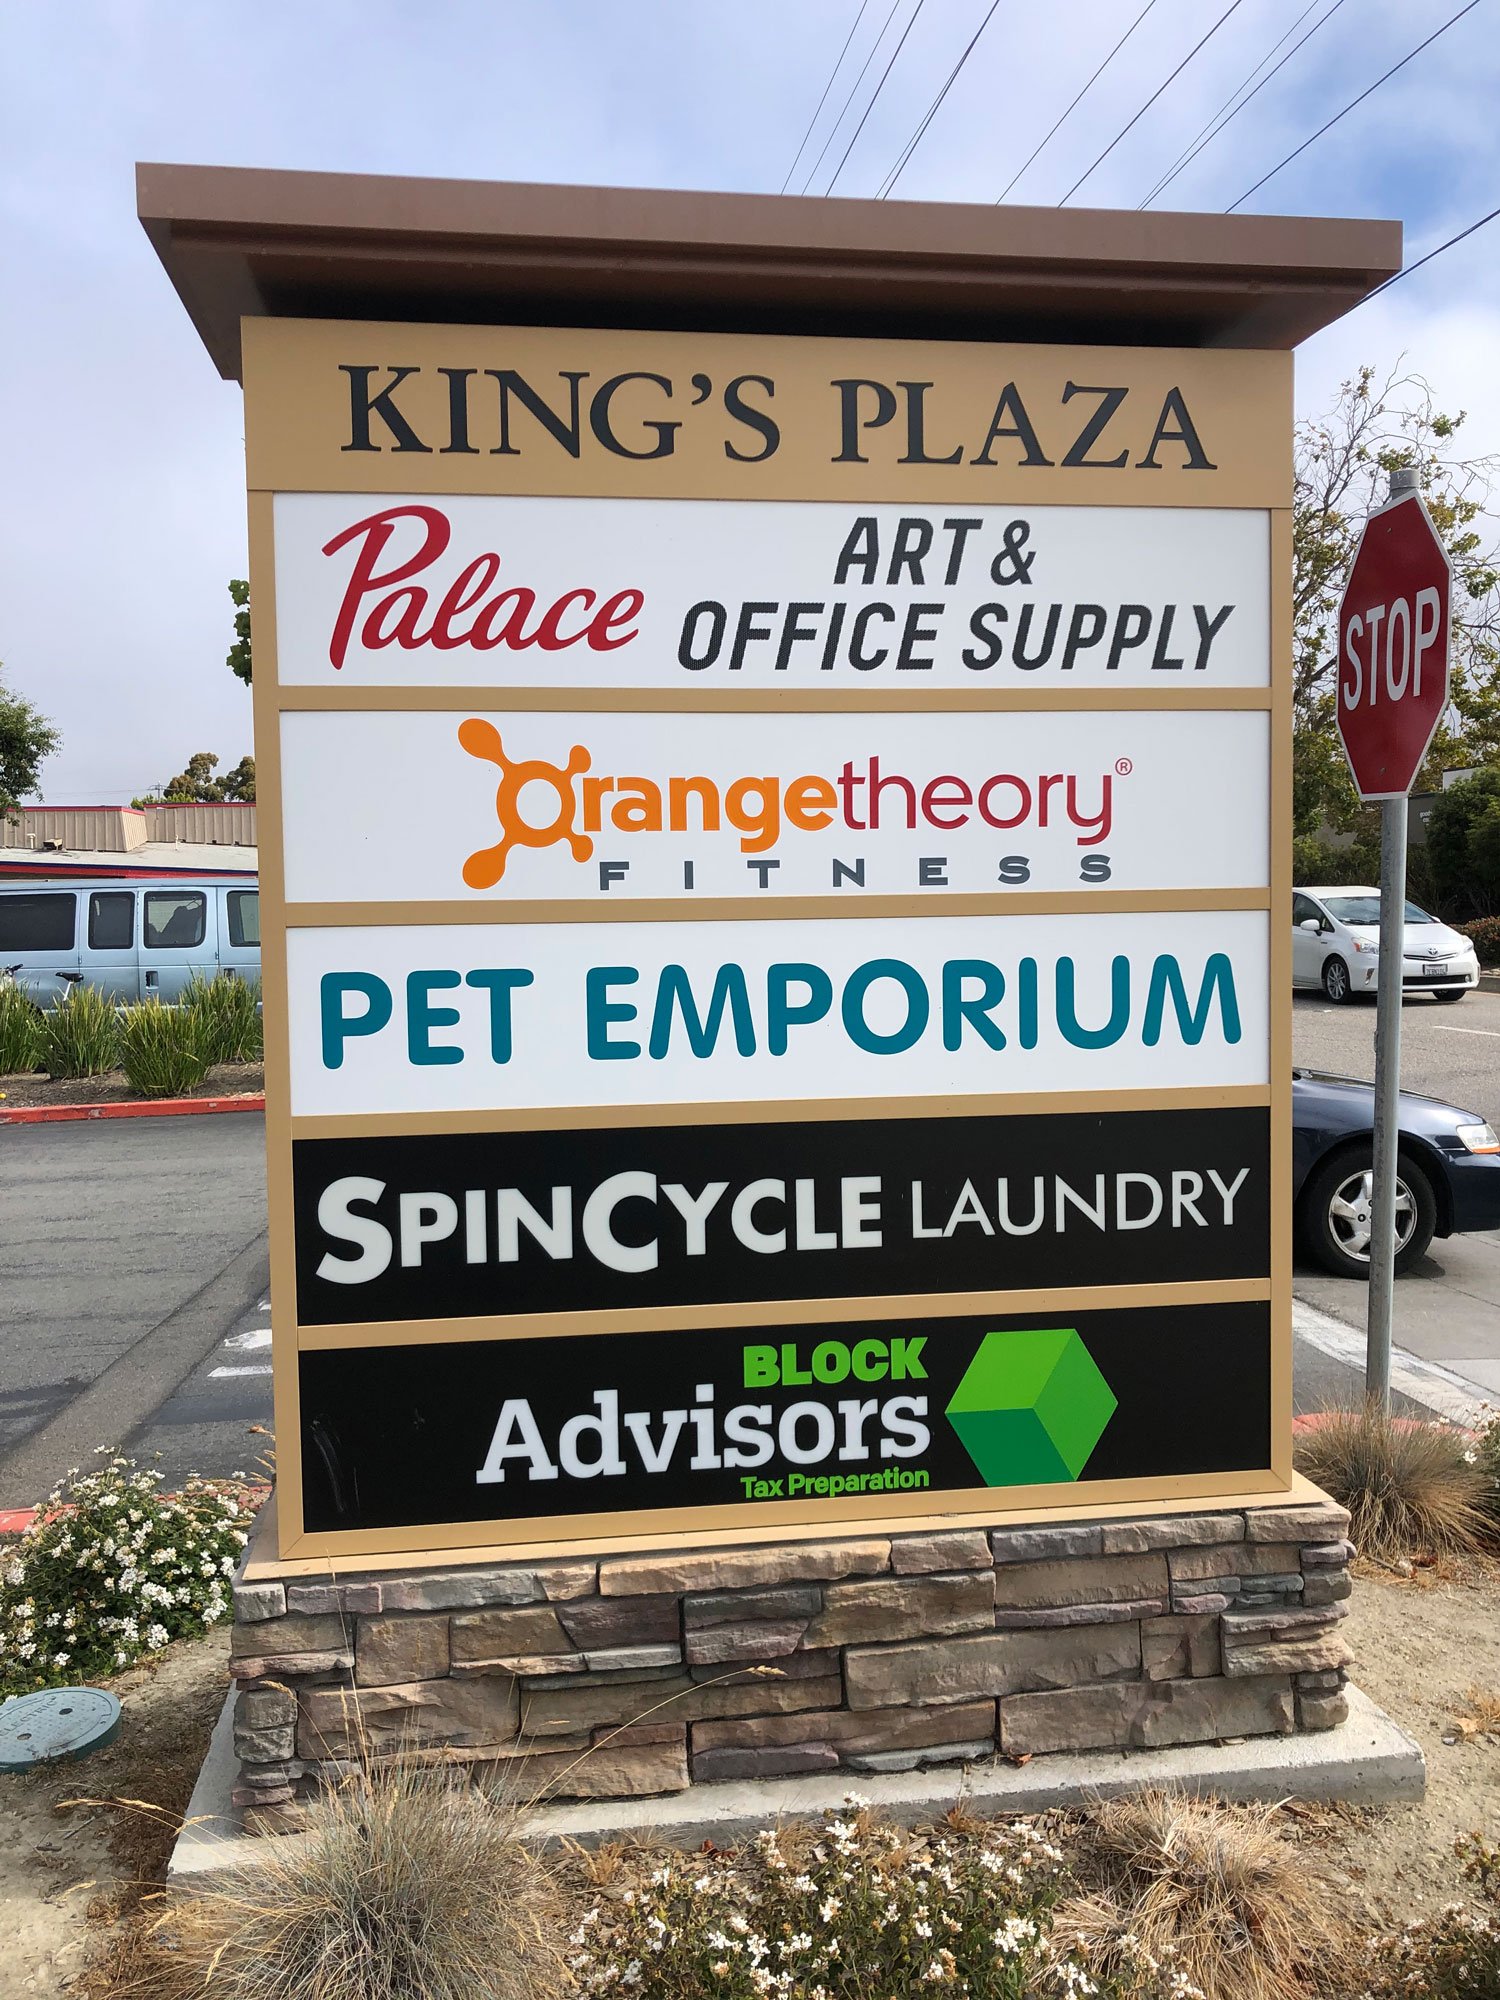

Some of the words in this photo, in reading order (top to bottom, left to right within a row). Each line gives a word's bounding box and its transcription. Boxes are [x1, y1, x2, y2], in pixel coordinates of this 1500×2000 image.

[338, 364, 781, 462] KING'S
[830, 378, 1219, 470] PLAZA
[321, 504, 645, 671] Palace
[833, 516, 983, 586] ART
[990, 518, 1037, 586] &
[677, 599, 946, 672] OFFICE
[961, 602, 1237, 672] SUPPLY
[1343, 585, 1441, 712] STOP
[599, 854, 1113, 891] FITNESS
[320, 968, 535, 1070] PET
[586, 953, 1242, 1061] EMPORIUM
[315, 1171, 883, 1286] SPINCYCLE
[911, 1168, 1251, 1240] LAUNDRY
[743, 1337, 929, 1388] BLOCK
[476, 1383, 932, 1485] Advisors
[740, 1476, 784, 1499] Tax
[788, 1466, 930, 1497] Preparation
